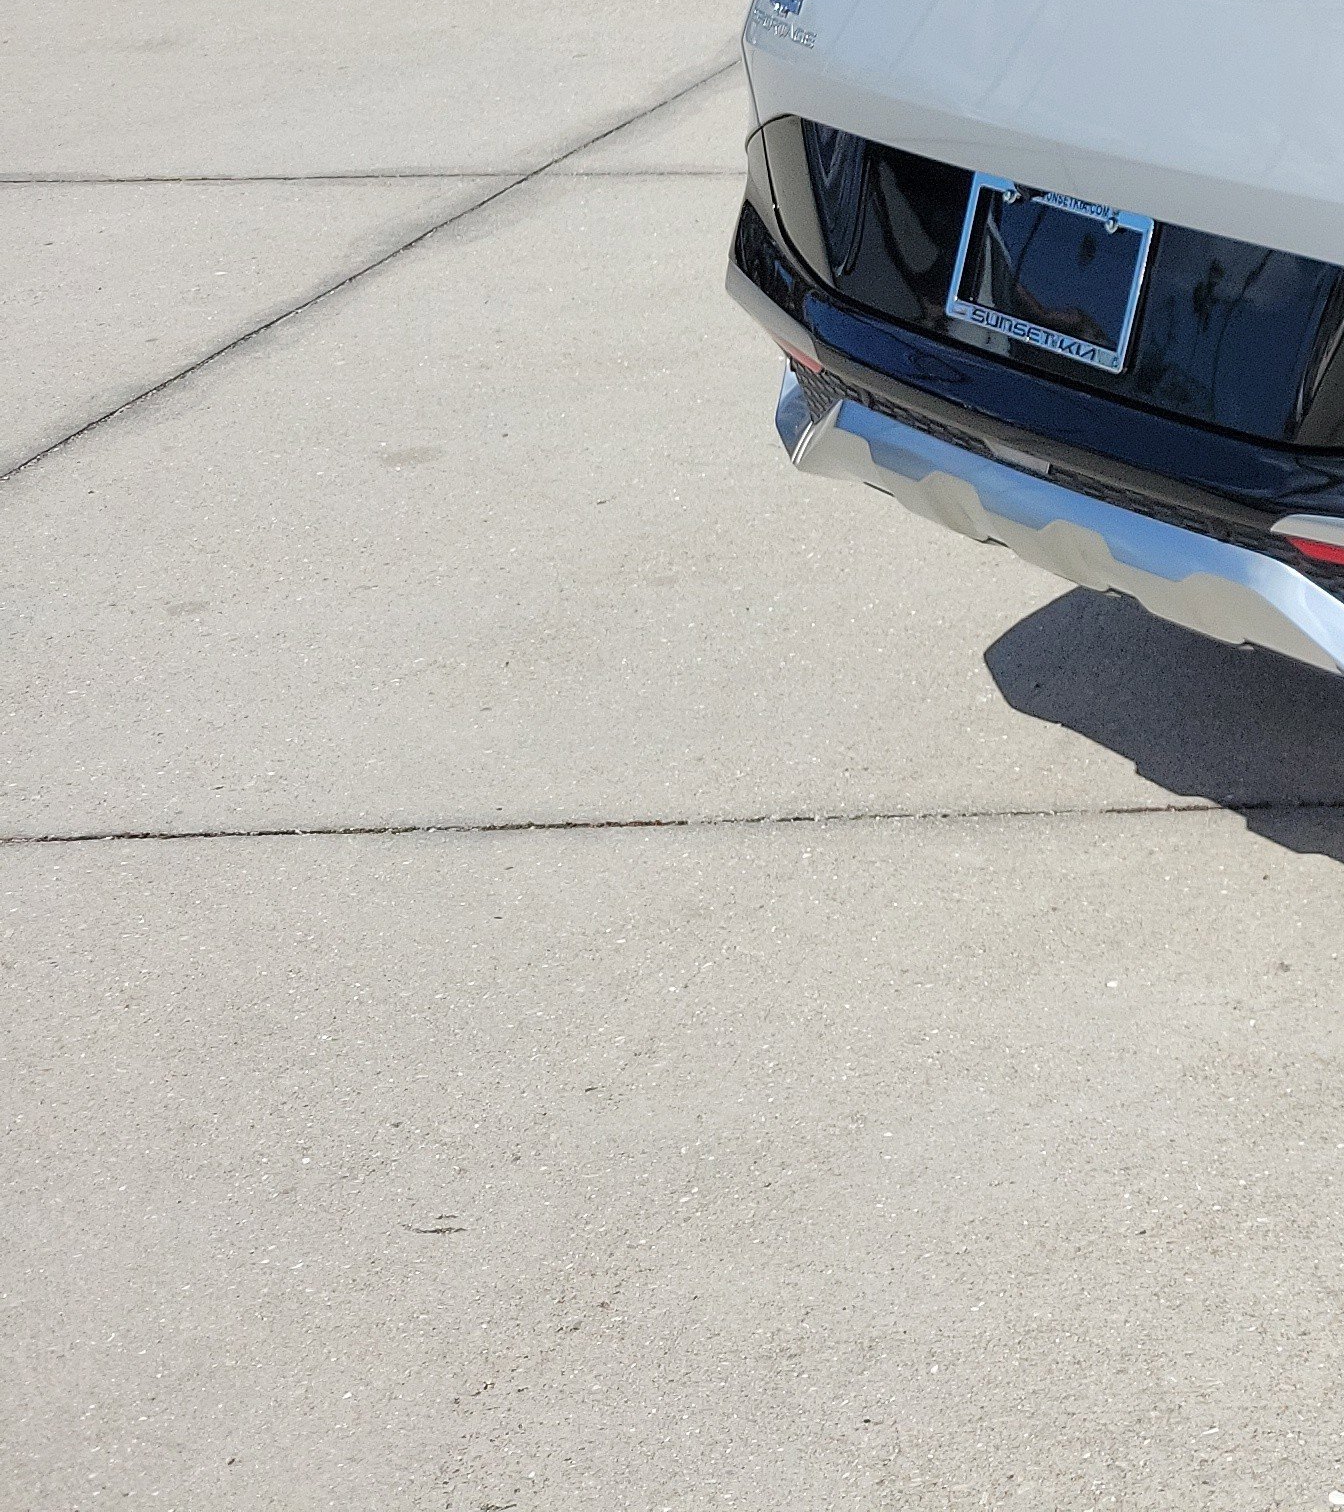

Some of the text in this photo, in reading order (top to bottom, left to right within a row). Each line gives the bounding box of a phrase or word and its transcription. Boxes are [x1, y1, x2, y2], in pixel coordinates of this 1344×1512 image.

[1044, 191, 1110, 218] UNSETKIA.COM
[972, 308, 1096, 361] SUNSET KIA
